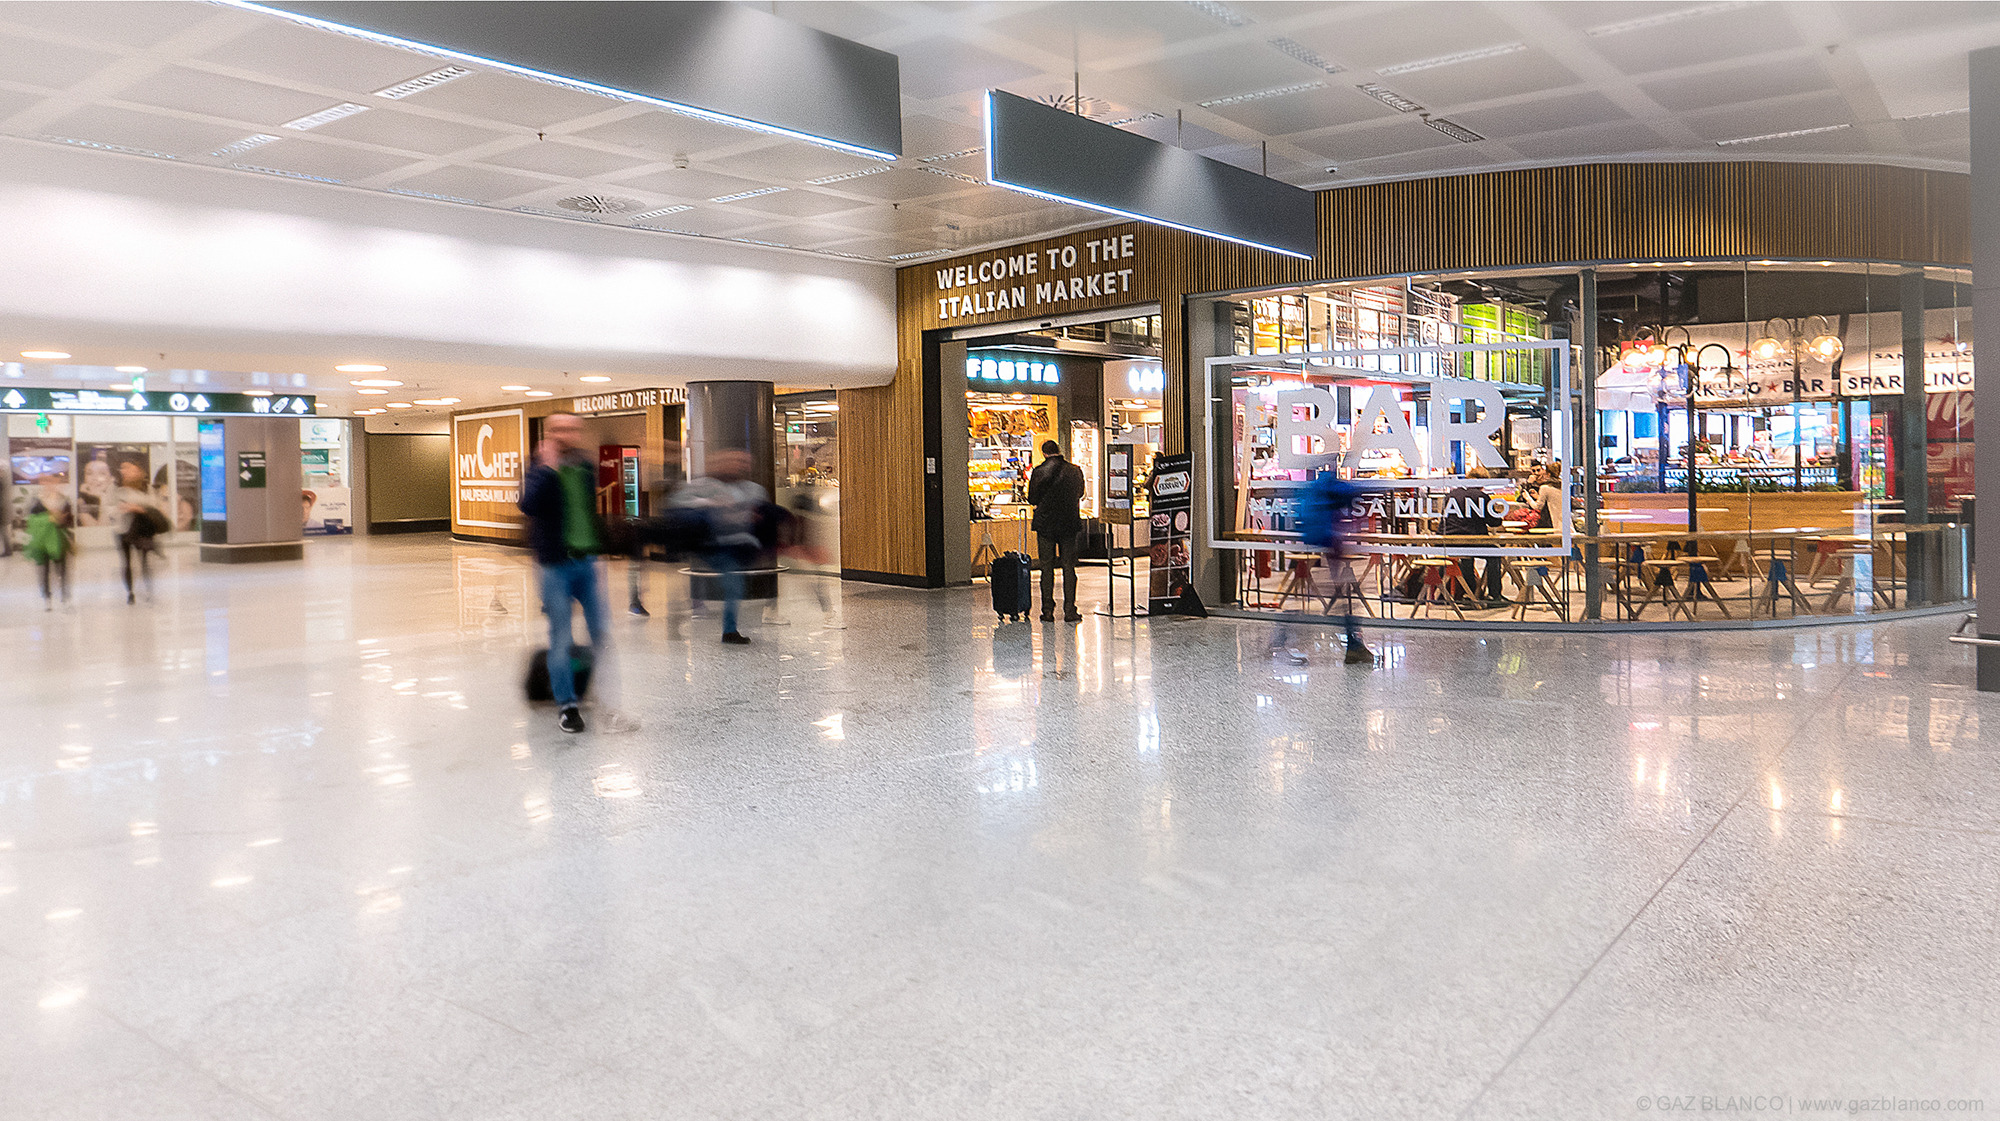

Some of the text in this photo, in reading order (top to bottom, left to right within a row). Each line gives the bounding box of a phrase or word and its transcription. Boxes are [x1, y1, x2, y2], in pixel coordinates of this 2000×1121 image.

[937, 234, 1134, 289] WELCOME TO THE
[939, 268, 1133, 319] ITALIAN MARKET
[966, 357, 1060, 384] FRUTTA
[1848, 371, 1972, 390] SPARING
[1783, 379, 1825, 393] BAR
[573, 394, 618, 412] WELCOME
[620, 392, 634, 408] TO
[636, 390, 657, 406] THE
[1278, 381, 1510, 469] BAR
[493, 489, 520, 503] MILANO
[1250, 497, 1510, 518] MALSA MILANO
